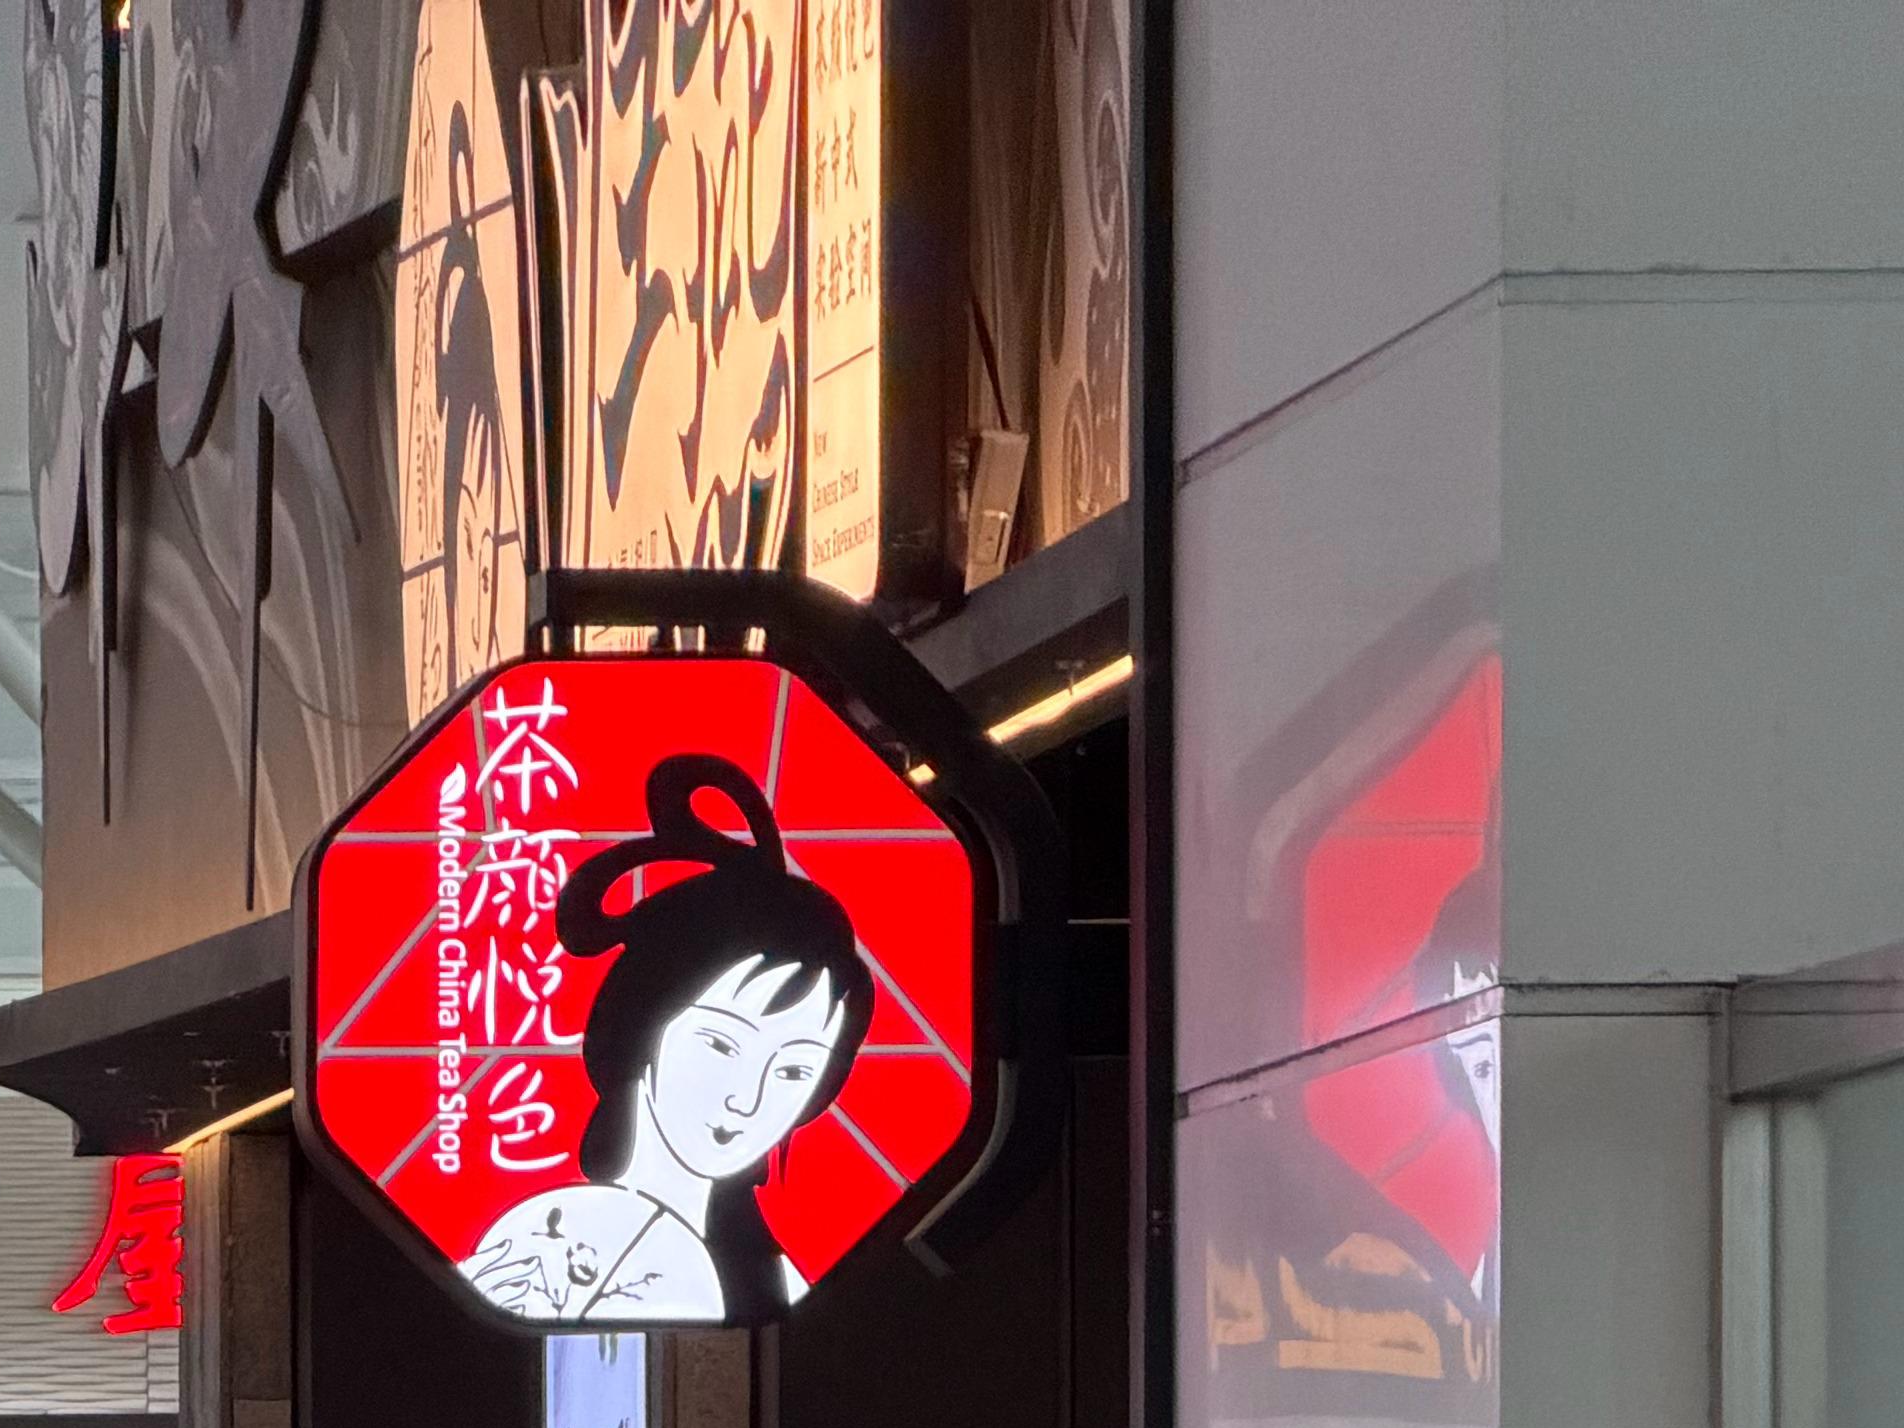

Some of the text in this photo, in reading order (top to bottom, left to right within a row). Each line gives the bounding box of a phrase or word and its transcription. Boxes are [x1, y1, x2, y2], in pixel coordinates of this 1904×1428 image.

[432, 804, 468, 1174] Modern China Tea Shop
